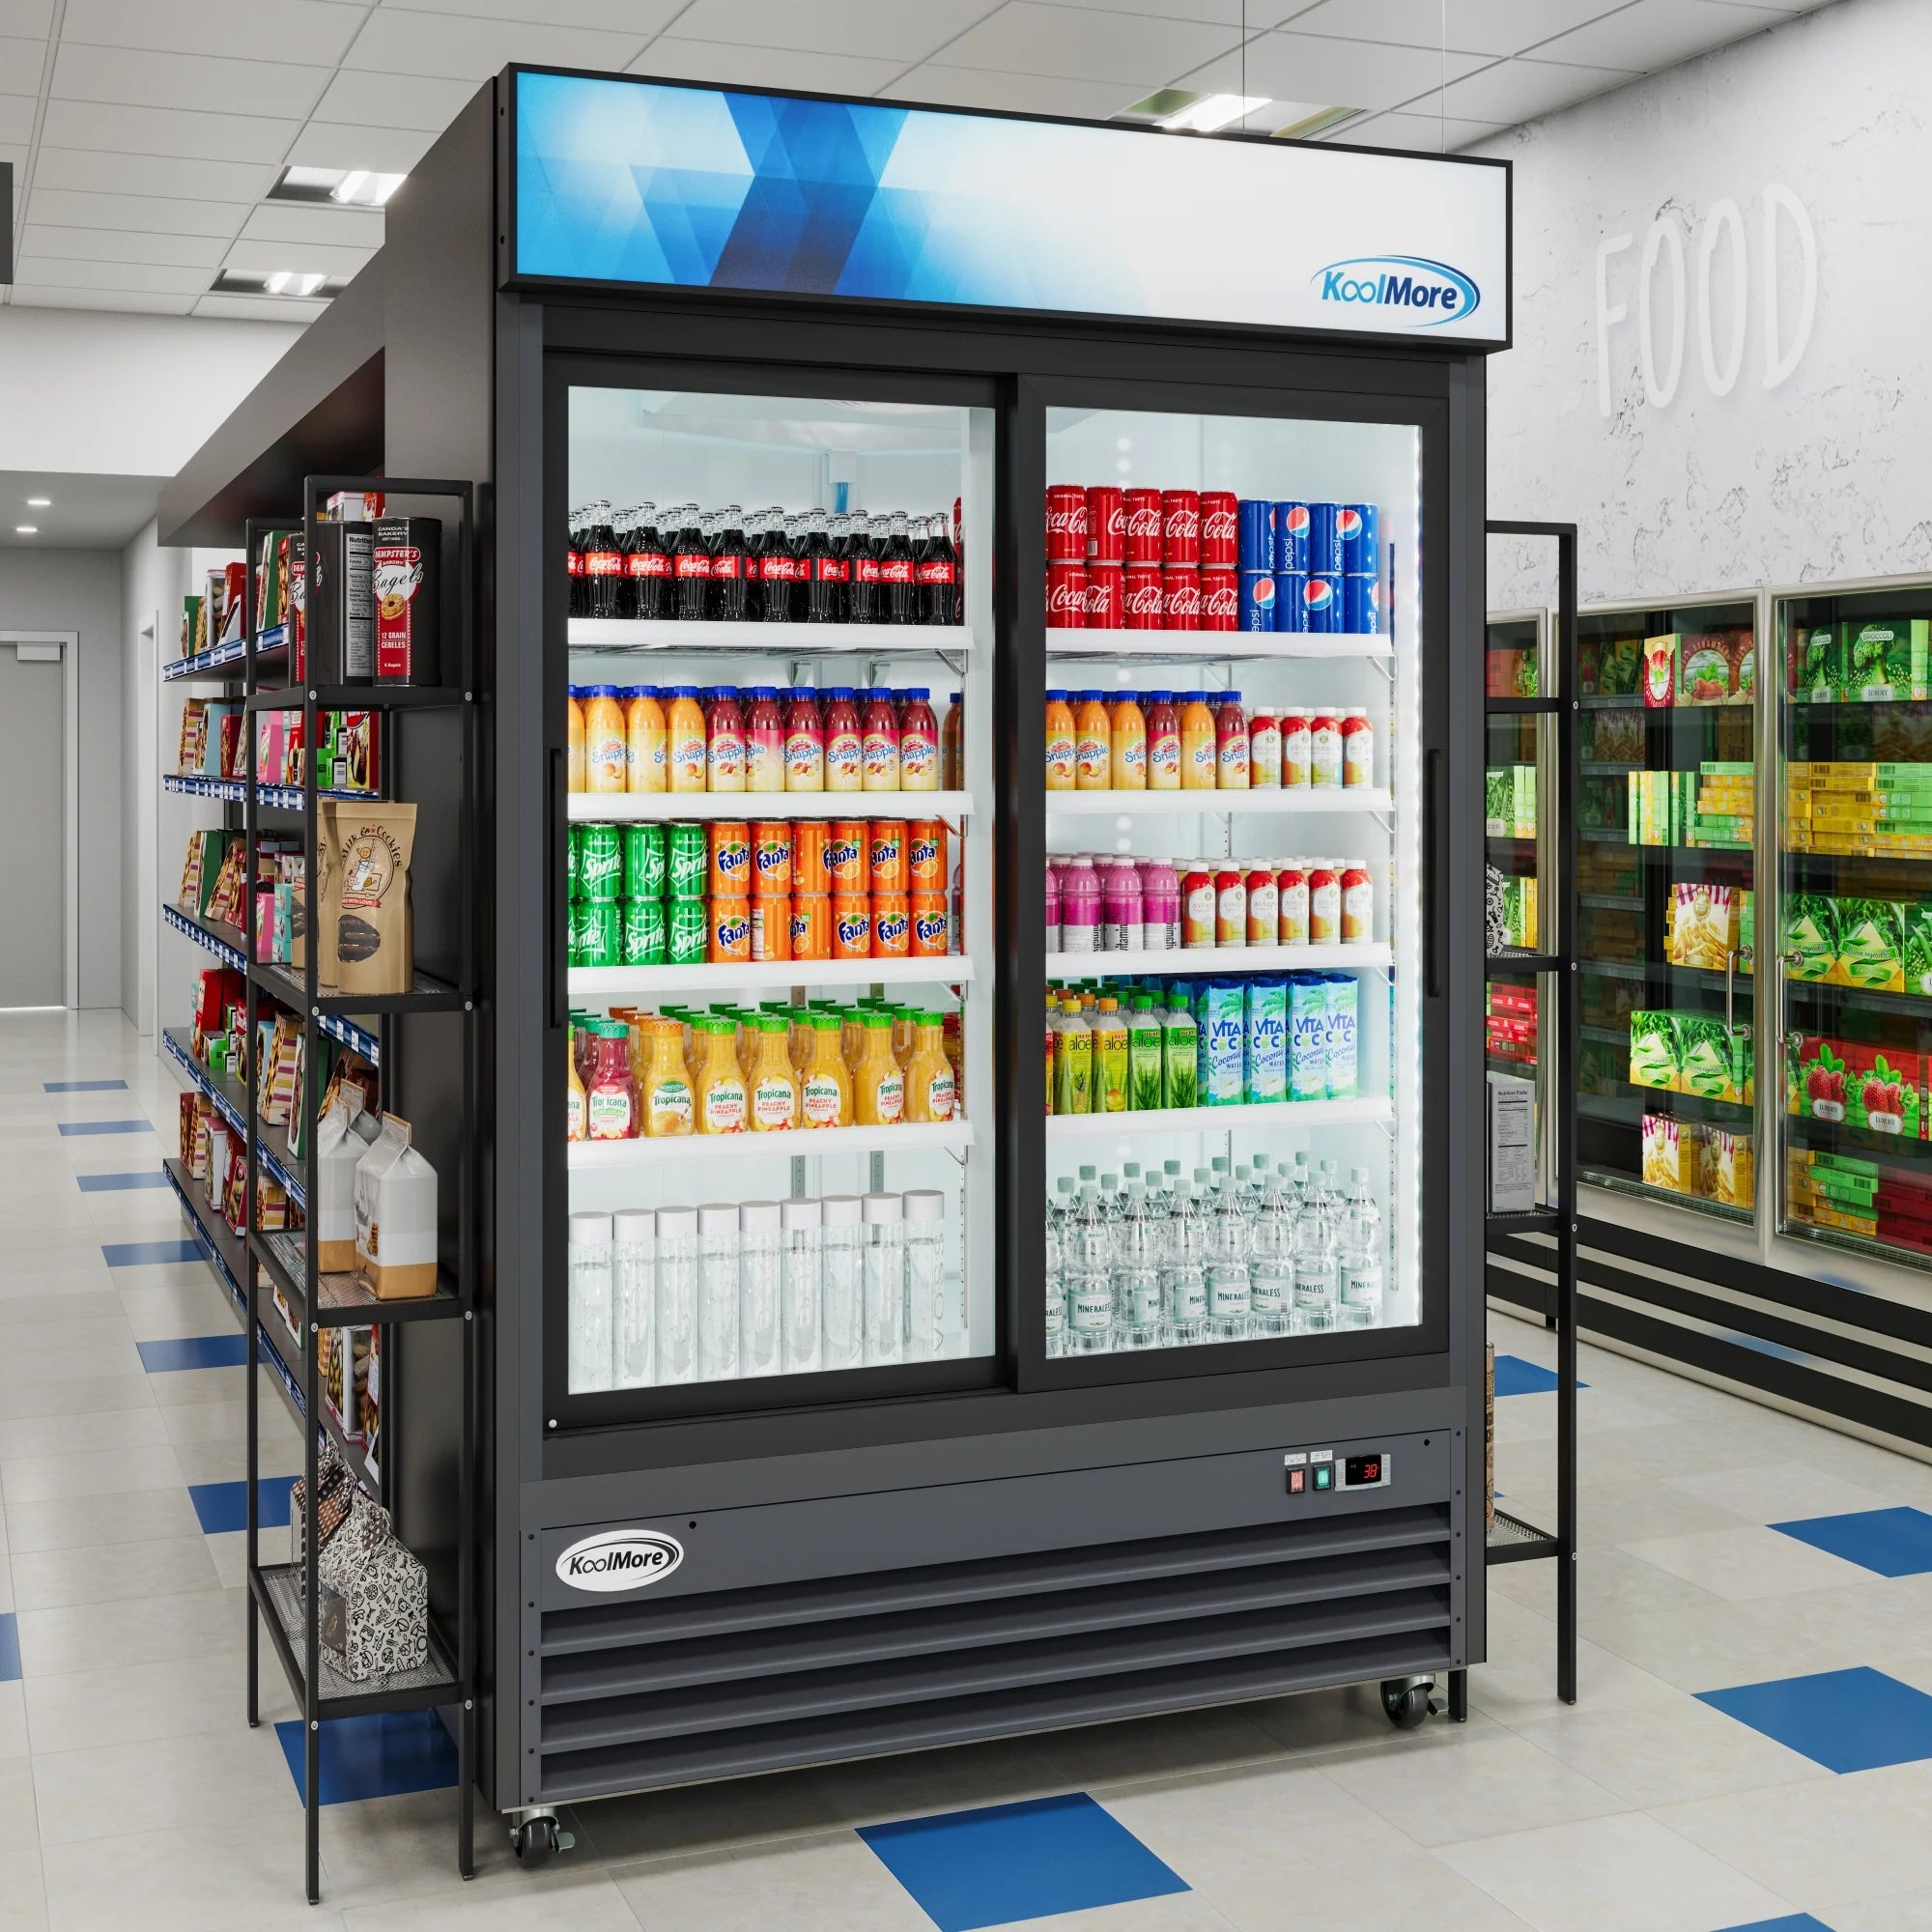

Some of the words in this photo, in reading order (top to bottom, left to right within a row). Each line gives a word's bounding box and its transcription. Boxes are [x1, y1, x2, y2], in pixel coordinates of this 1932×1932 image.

[1321, 271, 1458, 309] KoolMore
[1597, 183, 1817, 417] FOOD
[1284, 538, 1295, 570] pepsi
[1333, 539, 1345, 571] pepsi
[1250, 610, 1262, 633] epsi
[1302, 611, 1311, 634] epsi
[1367, 611, 1378, 635] epsi
[377, 825, 403, 867] Cookies
[831, 844, 858, 867] anta
[870, 844, 897, 867] anta
[910, 844, 936, 867] anta
[755, 846, 790, 872] Fanta
[1212, 1020, 1241, 1037] VITA
[1255, 1018, 1284, 1036] VITA
[1295, 1016, 1324, 1034] VITA
[1327, 1012, 1355, 1030] VITA
[1069, 1036, 1092, 1051] aloe
[1104, 1036, 1128, 1051] aloe
[1132, 1034, 1161, 1047] aloe
[1169, 1033, 1197, 1046] aloe
[654, 1094, 691, 1106] Tropicana
[709, 1092, 743, 1103] Tropicana
[757, 1088, 791, 1100] Tropicana
[805, 1086, 838, 1097] Tropicana
[1363, 1463, 1378, 1479] 38
[569, 1551, 664, 1576] KoolMore
